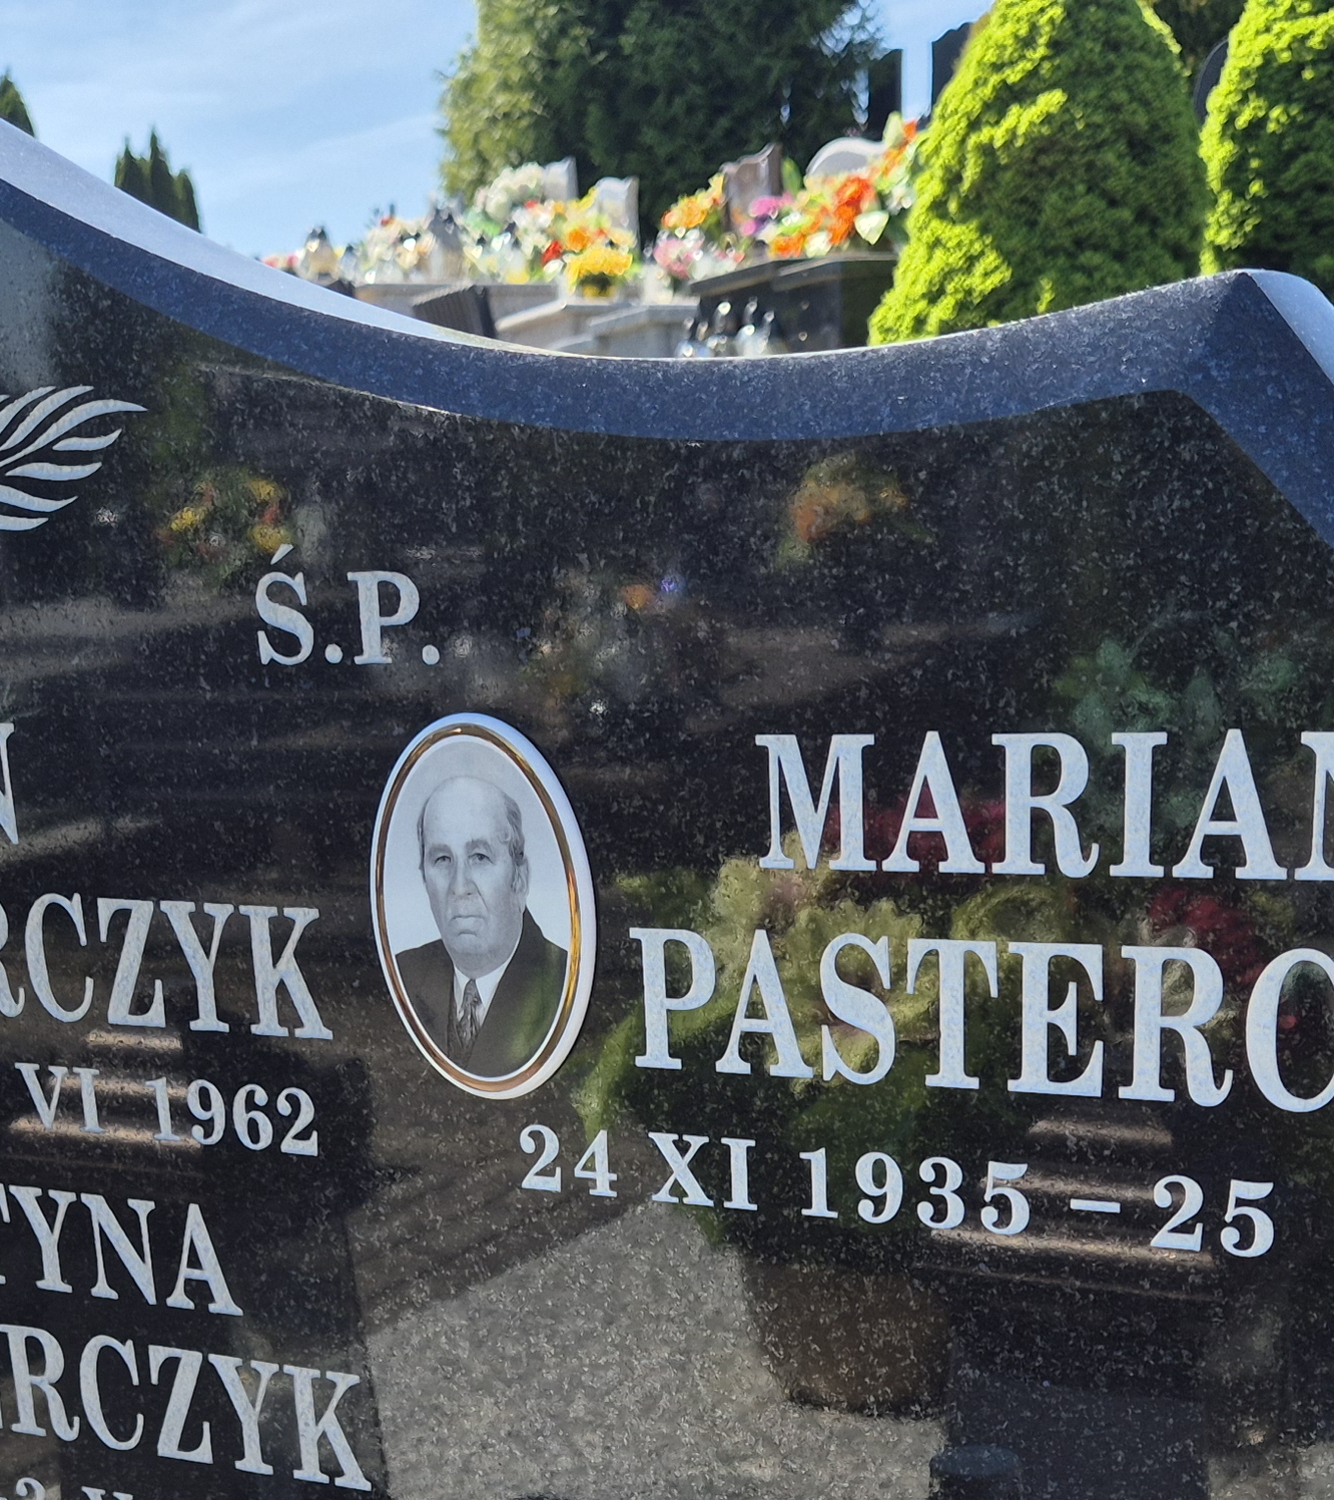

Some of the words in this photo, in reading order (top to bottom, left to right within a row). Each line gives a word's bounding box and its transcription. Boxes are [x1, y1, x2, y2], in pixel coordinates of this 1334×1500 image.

[15, 1062, 105, 1134] VI
[146, 1078, 319, 1156] 1962
[518, 1123, 617, 1200] 24
[648, 1130, 758, 1213] XI
[798, 1146, 1030, 1236] 1935
[1150, 1174, 1276, 1258] 25
